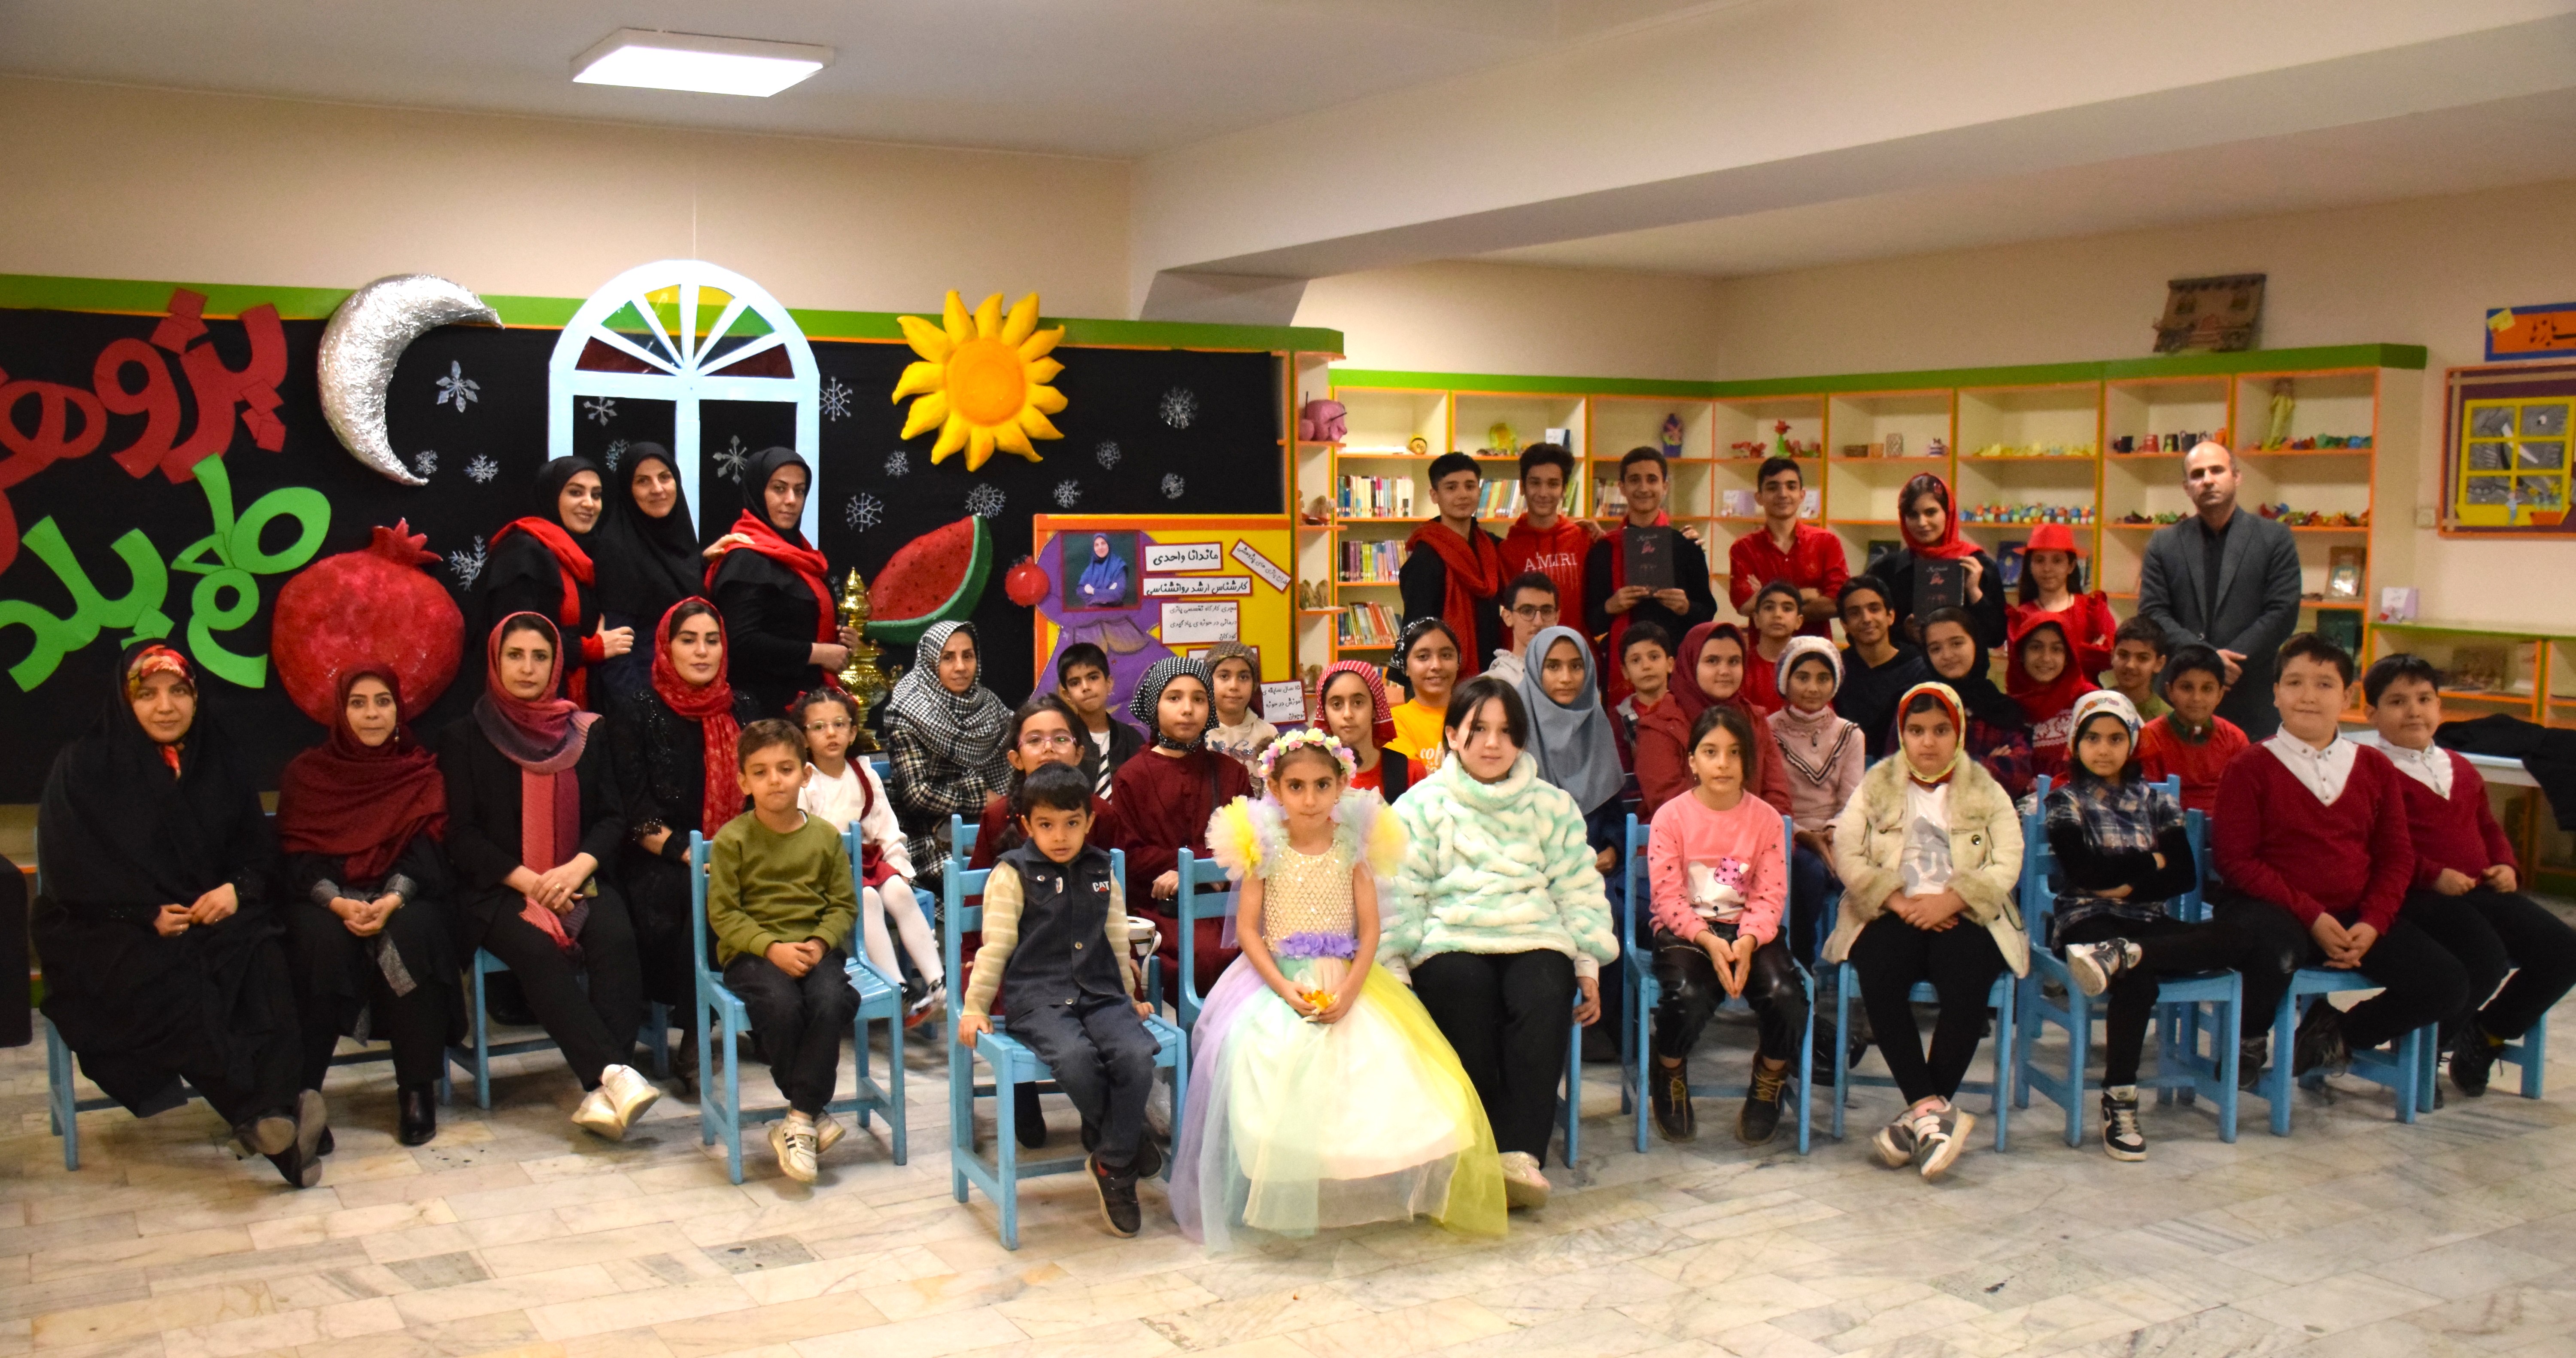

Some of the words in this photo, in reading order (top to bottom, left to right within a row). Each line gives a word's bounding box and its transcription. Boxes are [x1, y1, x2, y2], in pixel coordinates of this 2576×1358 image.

[1153, 551, 1185, 565] واحدی
[1188, 549, 1218, 561] ماندانا
[1524, 552, 1578, 572] AMIRI
[1146, 582, 1189, 595] روانشناسی
[1191, 581, 1209, 593] ارشد
[1211, 580, 1248, 594] کارشناس
[0, 515, 174, 692] یلد
[1219, 633, 1236, 641] کودکان
[1285, 697, 1303, 707] آموزش
[1092, 881, 1110, 892] CAT
